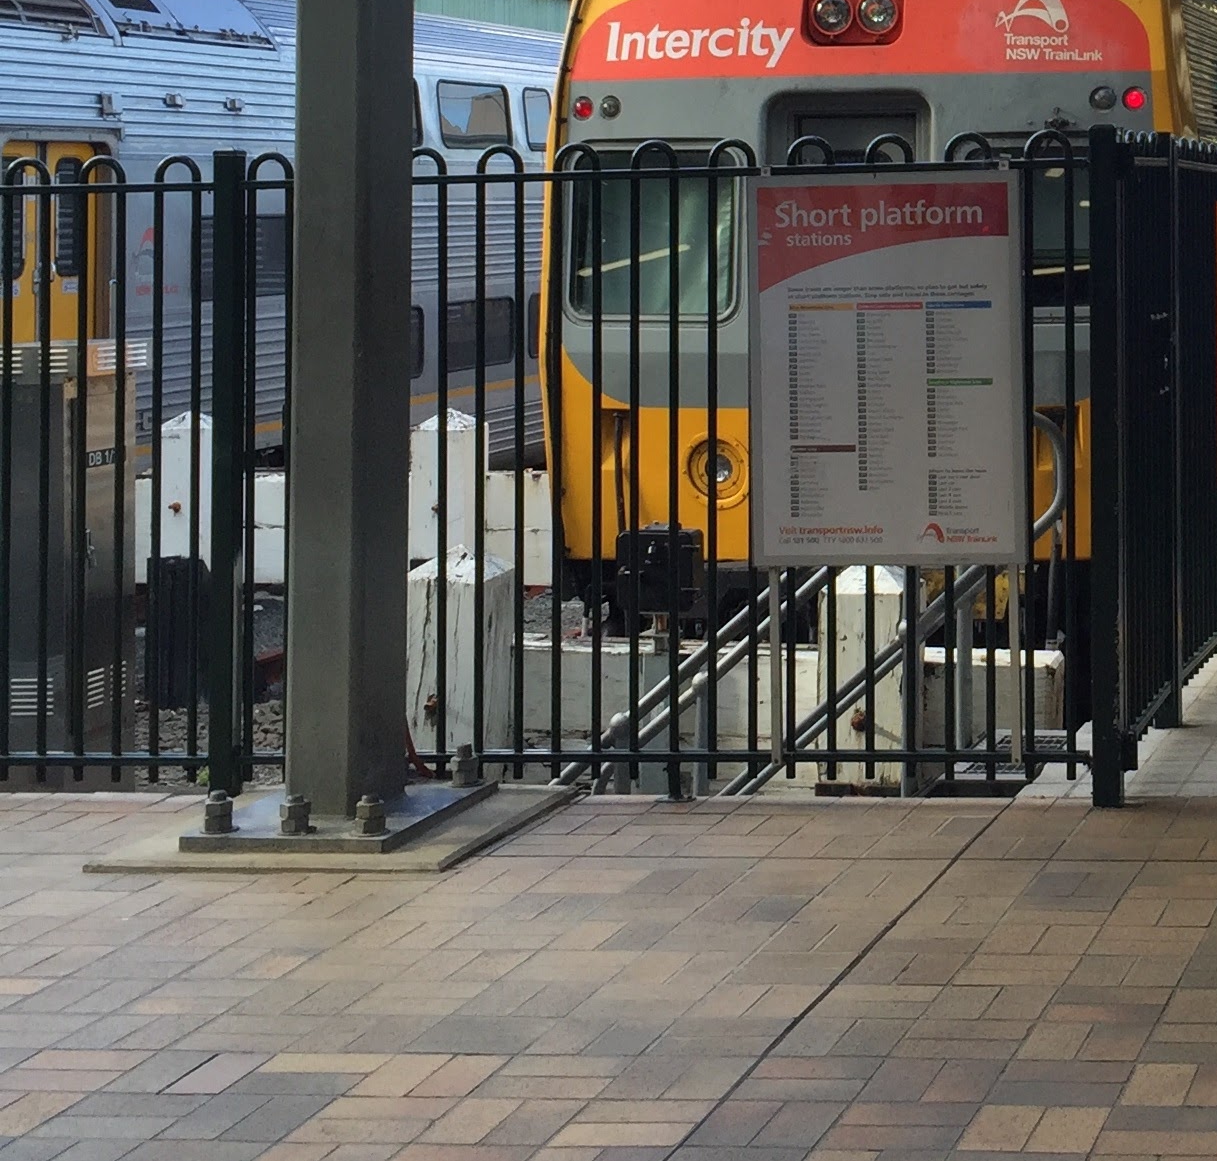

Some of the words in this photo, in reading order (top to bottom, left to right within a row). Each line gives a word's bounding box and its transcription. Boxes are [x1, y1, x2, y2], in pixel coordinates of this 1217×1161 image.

[606, 18, 795, 68] Intercity
[1004, 33, 1068, 48] Transport
[1005, 49, 1040, 61] NSW
[1043, 48, 1102, 62] TrainLink
[775, 200, 852, 228] Short
[860, 200, 983, 232] platform
[786, 231, 852, 247] stations
[88, 452, 103, 466] DB
[799, 524, 884, 536] transportnsw.info
